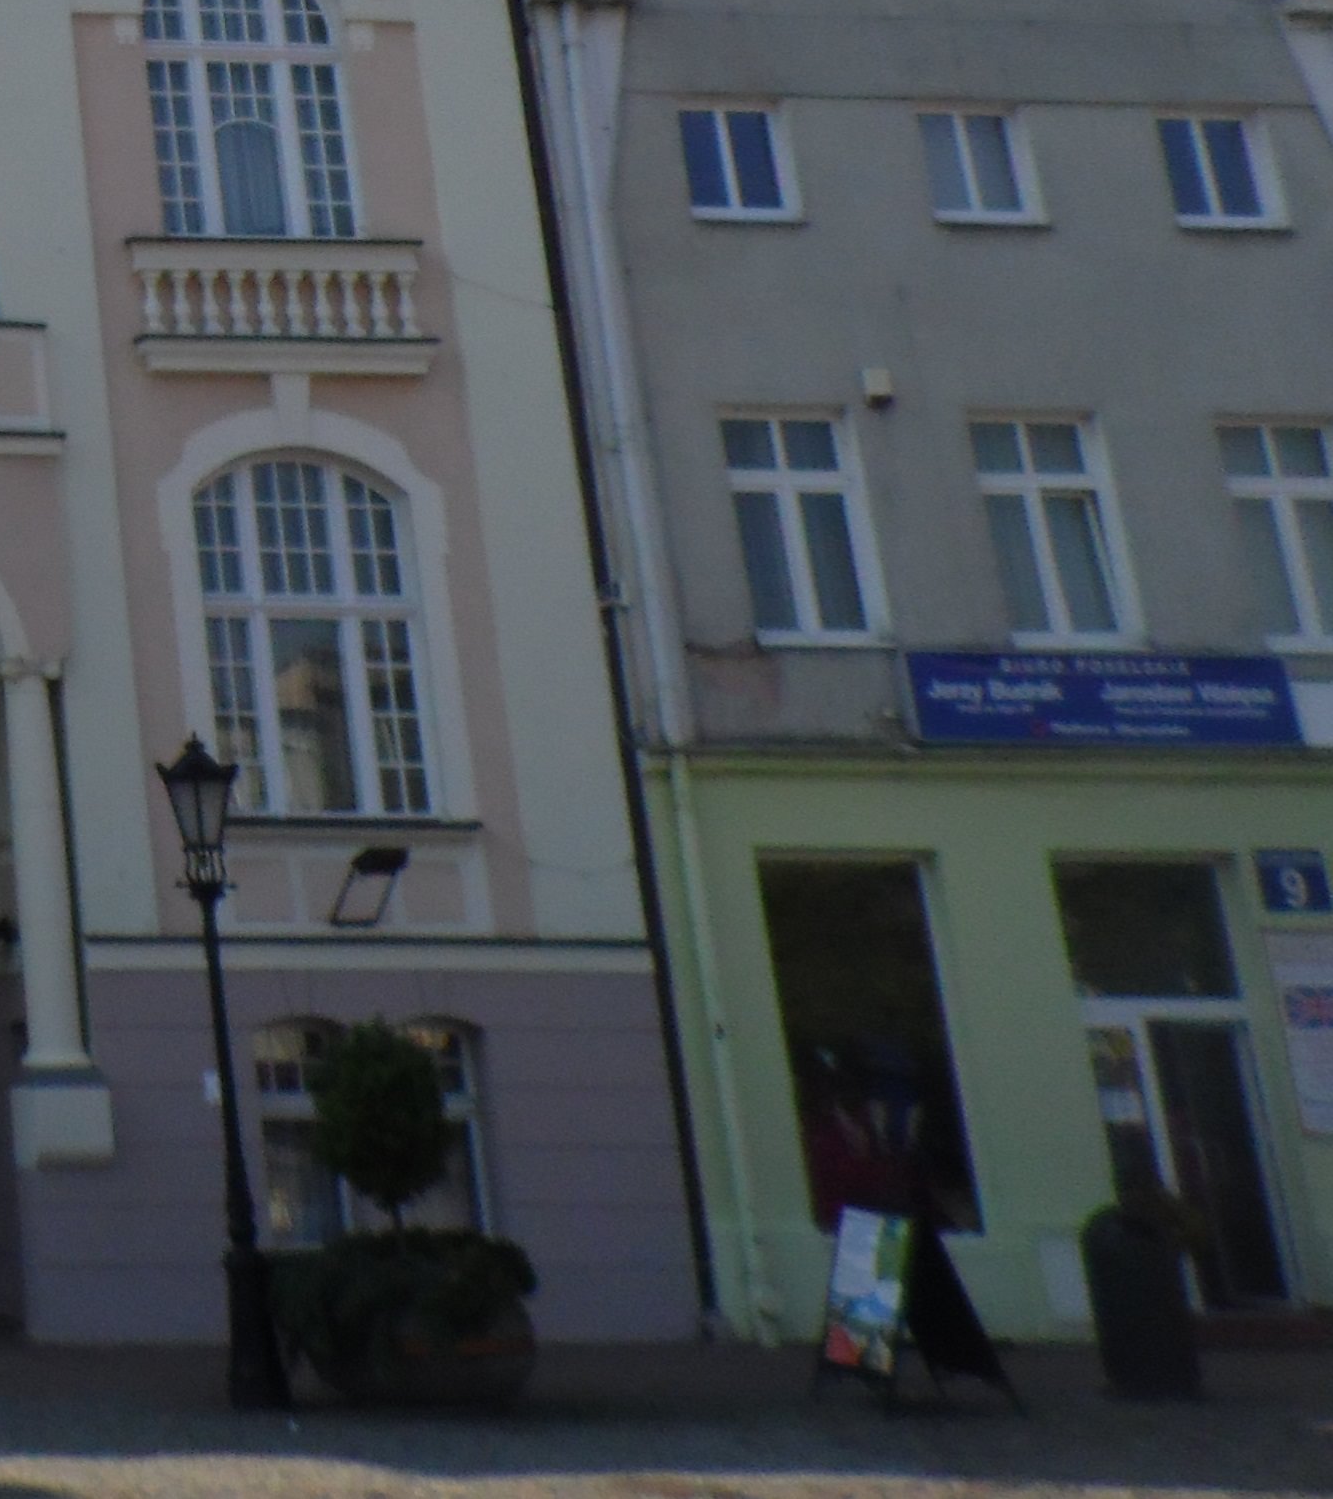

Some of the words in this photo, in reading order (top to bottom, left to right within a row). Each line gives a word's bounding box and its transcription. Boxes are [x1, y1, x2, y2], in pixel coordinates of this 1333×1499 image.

[998, 657, 1065, 673] BIURO
[1074, 658, 1191, 676] POSELSKIE
[1280, 867, 1308, 908] 9
